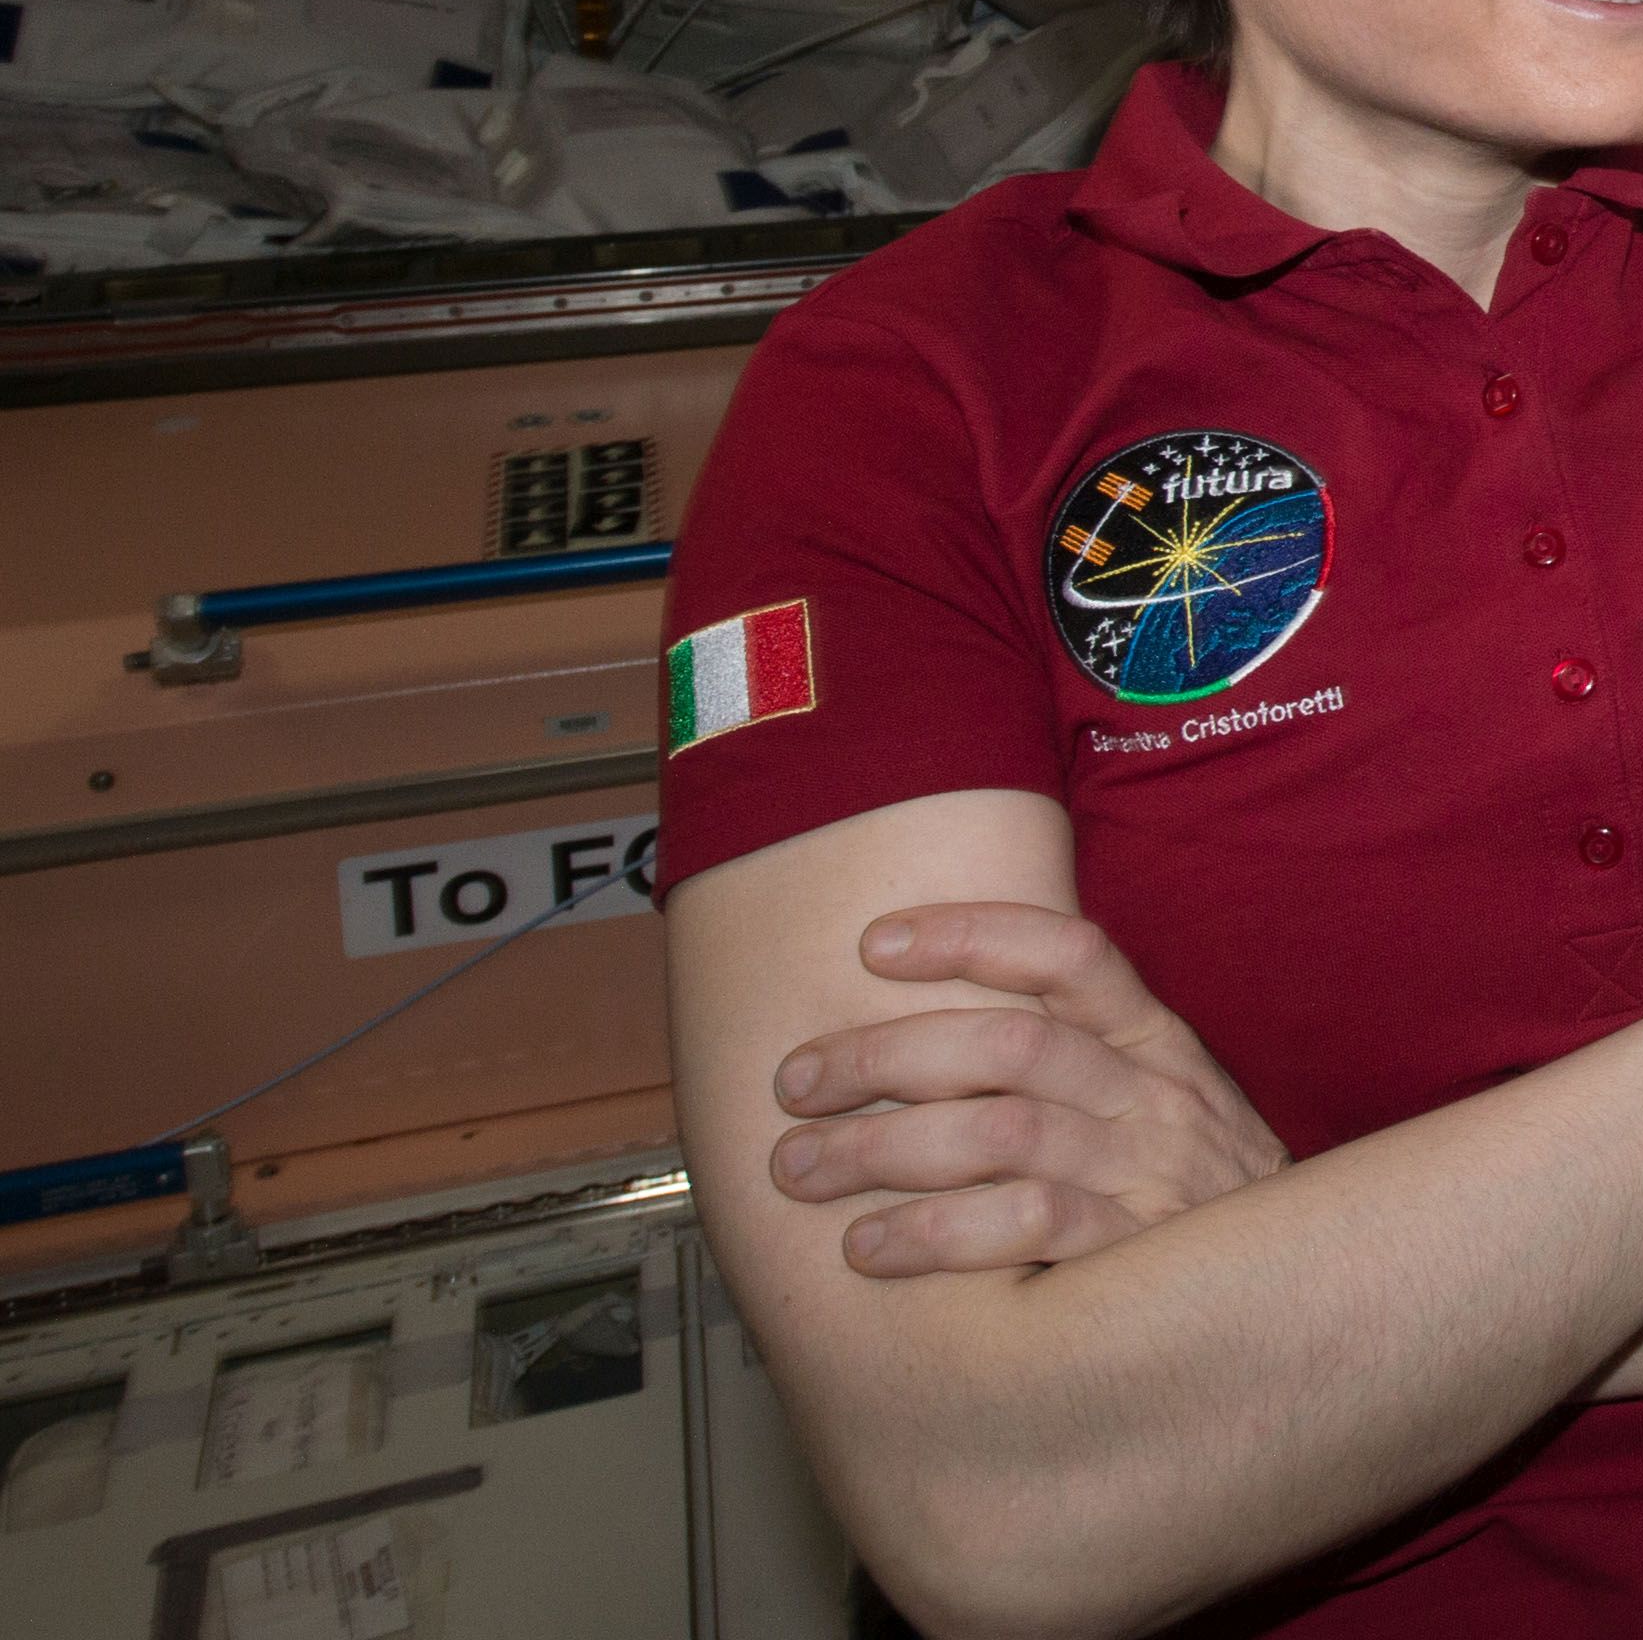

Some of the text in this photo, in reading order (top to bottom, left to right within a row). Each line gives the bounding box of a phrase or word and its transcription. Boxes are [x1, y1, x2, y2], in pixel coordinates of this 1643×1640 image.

[1161, 464, 1295, 505] futura
[1090, 684, 1345, 754] Samantha Cristoforetti
[363, 860, 509, 938] To
